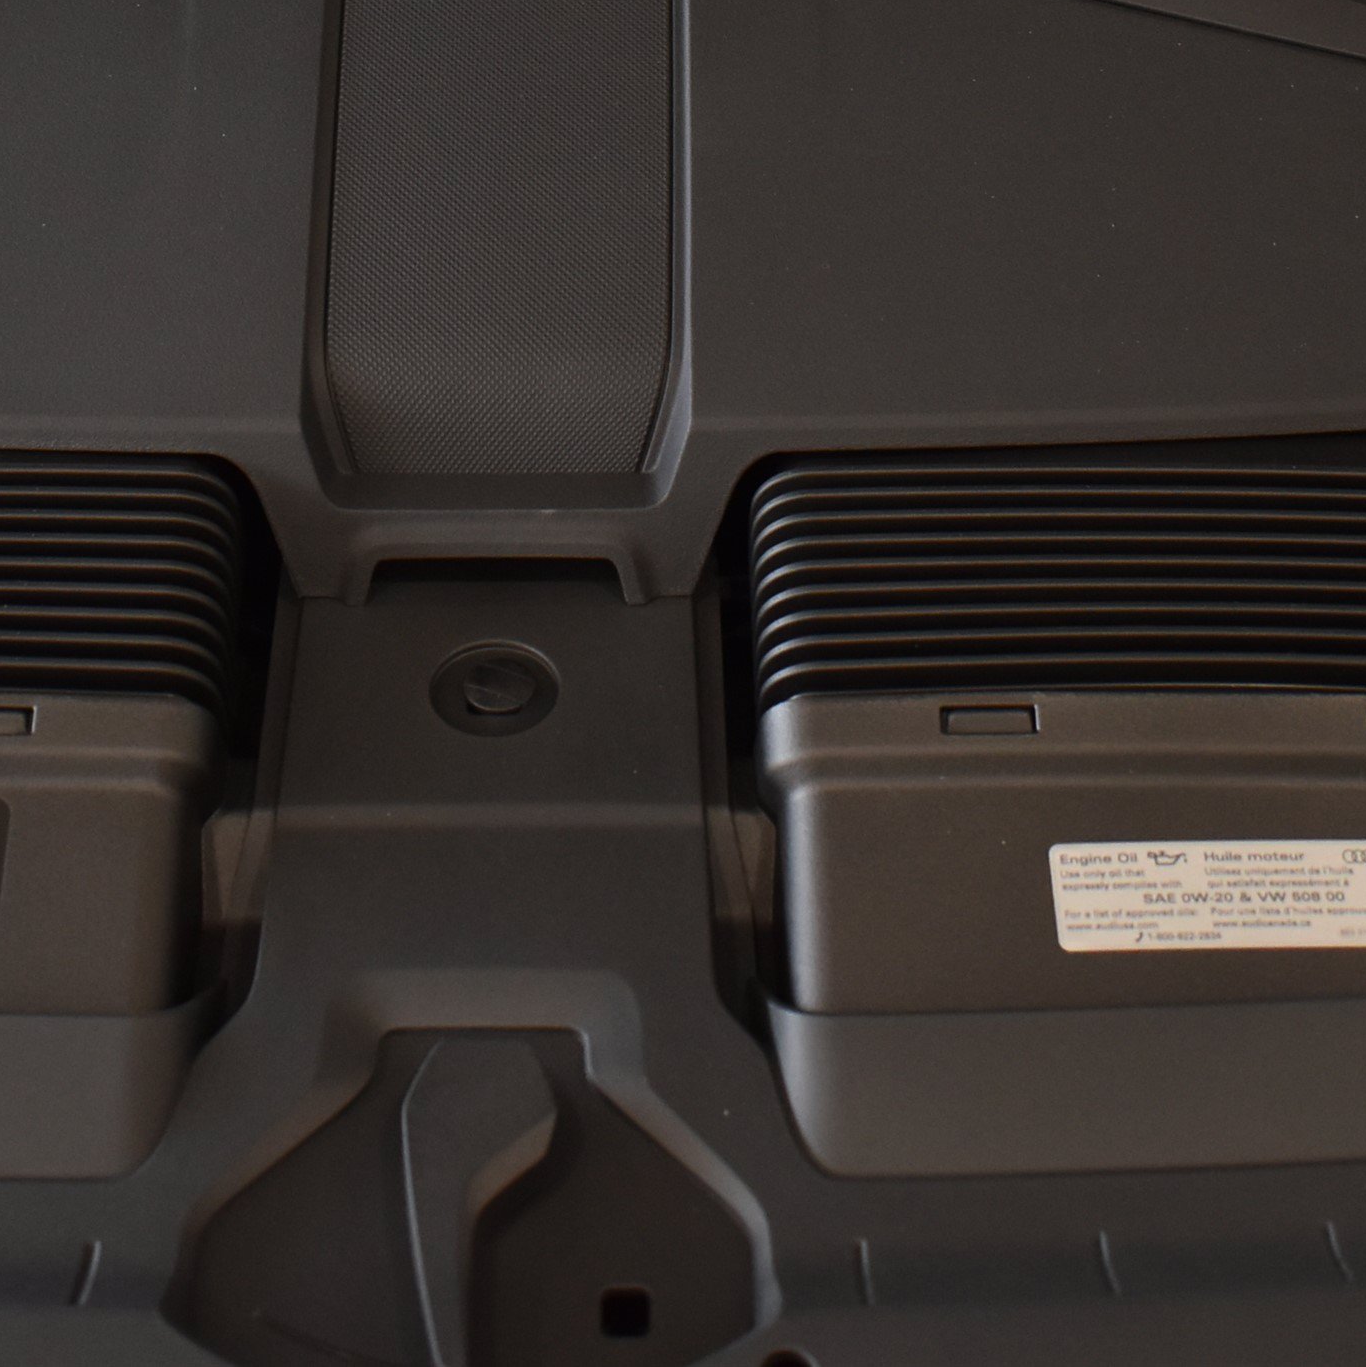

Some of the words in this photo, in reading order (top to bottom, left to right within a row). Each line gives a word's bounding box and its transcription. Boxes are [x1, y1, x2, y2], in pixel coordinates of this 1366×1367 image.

[1059, 853, 1112, 866] Engine
[1117, 852, 1138, 864] Oil
[1203, 851, 1243, 862] Huile
[1247, 851, 1305, 862] moteur
[1143, 892, 1177, 905] SAE
[1182, 891, 1234, 904] 0W-20
[1239, 891, 1252, 903] &
[1256, 890, 1288, 903] VW
[1291, 890, 1321, 902] 508
[1325, 890, 1345, 902] 00
